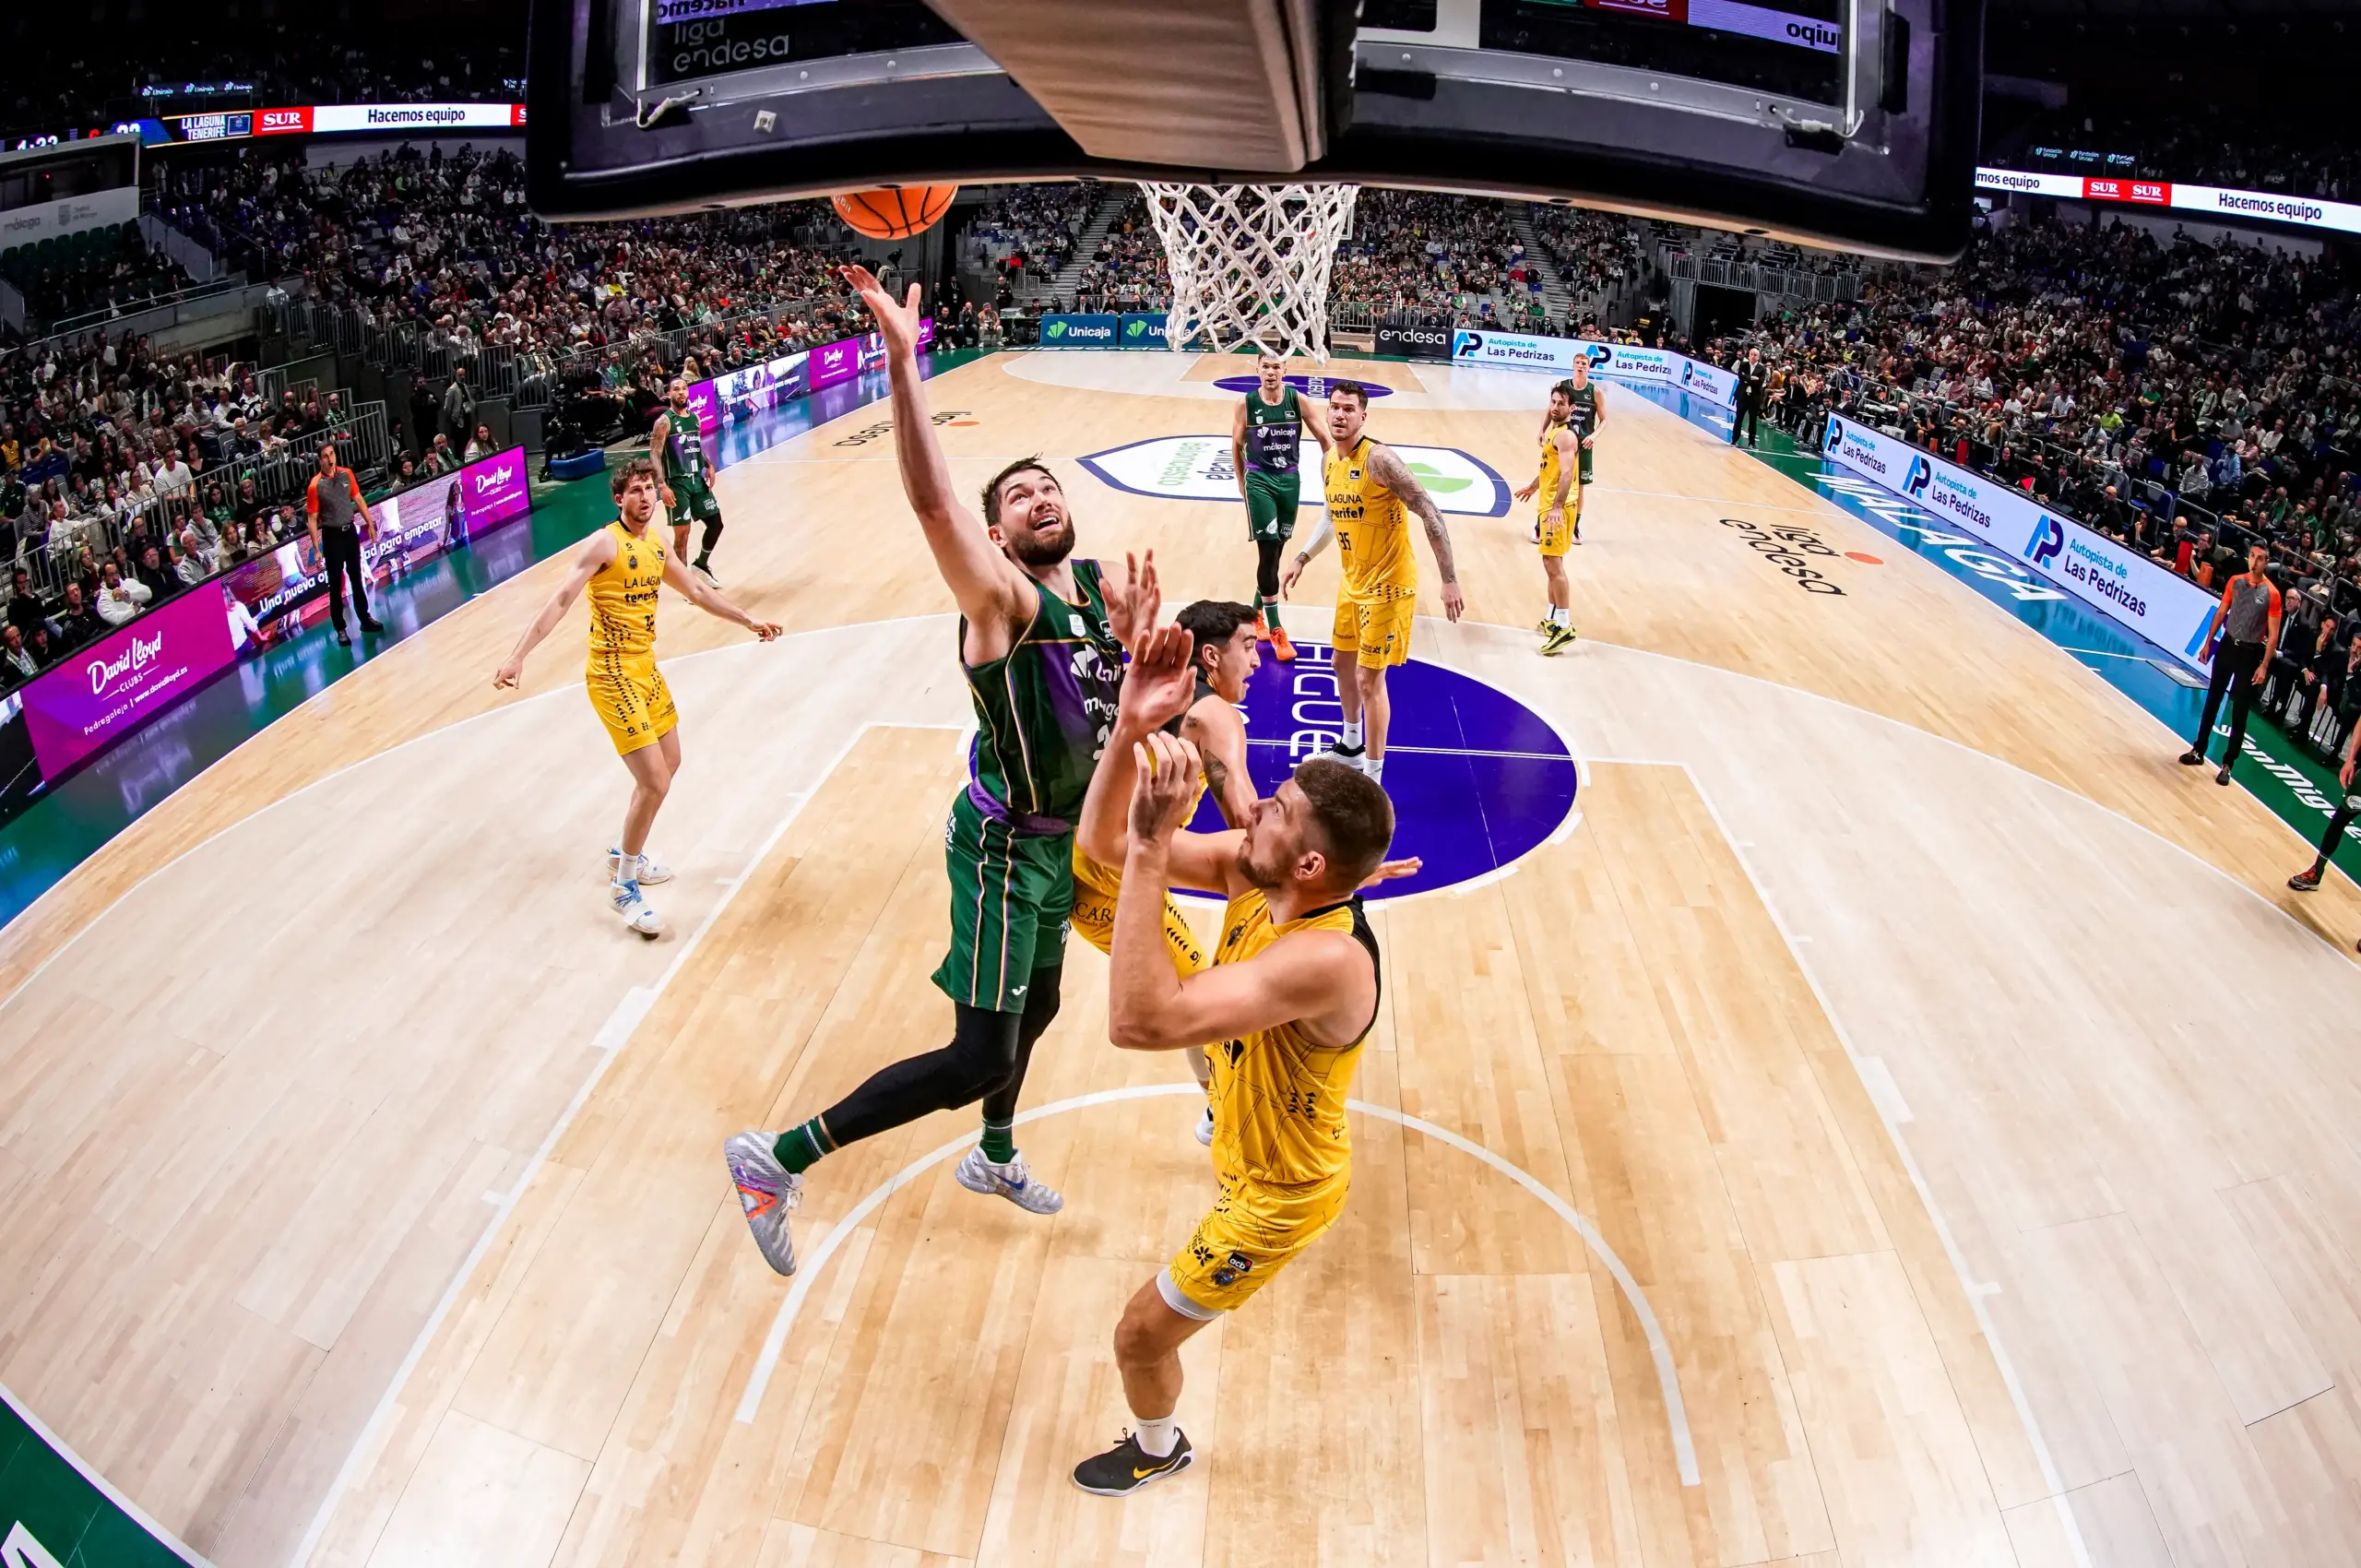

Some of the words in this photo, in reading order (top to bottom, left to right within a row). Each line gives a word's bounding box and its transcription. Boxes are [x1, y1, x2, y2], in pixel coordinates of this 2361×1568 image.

[674, 18, 725, 46] liga
[673, 35, 789, 72] endesa
[182, 118, 193, 129] LA
[195, 115, 225, 128] LAGUNA
[263, 112, 301, 126] SUR
[368, 109, 423, 123] Hacemos
[426, 107, 465, 124] equipo
[187, 126, 225, 140] TENERIFE
[2003, 173, 2040, 190] equipo
[2090, 182, 2118, 194] SUR
[2131, 184, 2163, 197] SUR
[2219, 193, 2274, 213] Hacemos
[2276, 202, 2322, 222] equipo
[1068, 327, 1111, 340] Unicaja
[1379, 328, 1446, 345] endesa
[1488, 338, 1525, 349] Autopista
[1527, 340, 1537, 349] de
[1487, 347, 1506, 357] Las
[1509, 349, 1555, 362] Pedrizas
[1617, 350, 1653, 362] Autopista
[1654, 355, 1663, 363] de
[1616, 359, 1633, 370] Las
[1700, 379, 1718, 395] Pedrizas
[1270, 429, 1296, 437] Unicaja
[1845, 430, 1868, 449] Autopista
[1869, 442, 1876, 451] de
[1843, 442, 1855, 457] Las
[1856, 447, 1886, 474] Pedrizas
[1935, 471, 1967, 495] Autopista
[1968, 487, 1977, 500] de
[1330, 493, 1362, 504] LAGUNA
[1931, 485, 1948, 506] Las
[1949, 493, 1991, 529] Pedrizas
[1770, 524, 1841, 557] liga
[259, 595, 282, 613] Una
[284, 578, 315, 605] nueva
[379, 534, 401, 555] para
[404, 516, 443, 540] empezar
[1719, 518, 1848, 597] endesa
[2069, 538, 2114, 572] Autopista
[2115, 563, 2128, 579] de
[624, 577, 638, 588] LA
[2064, 554, 2085, 581] Las
[2087, 568, 2146, 617] Pedrizas
[87, 649, 129, 695] David
[132, 631, 161, 671] Lloyd
[119, 672, 144, 693] CLUBS
[84, 704, 128, 735] Pedregalejo
[135, 667, 188, 703] www.davidlloyd.es
[1229, 1258, 1245, 1269] acb
